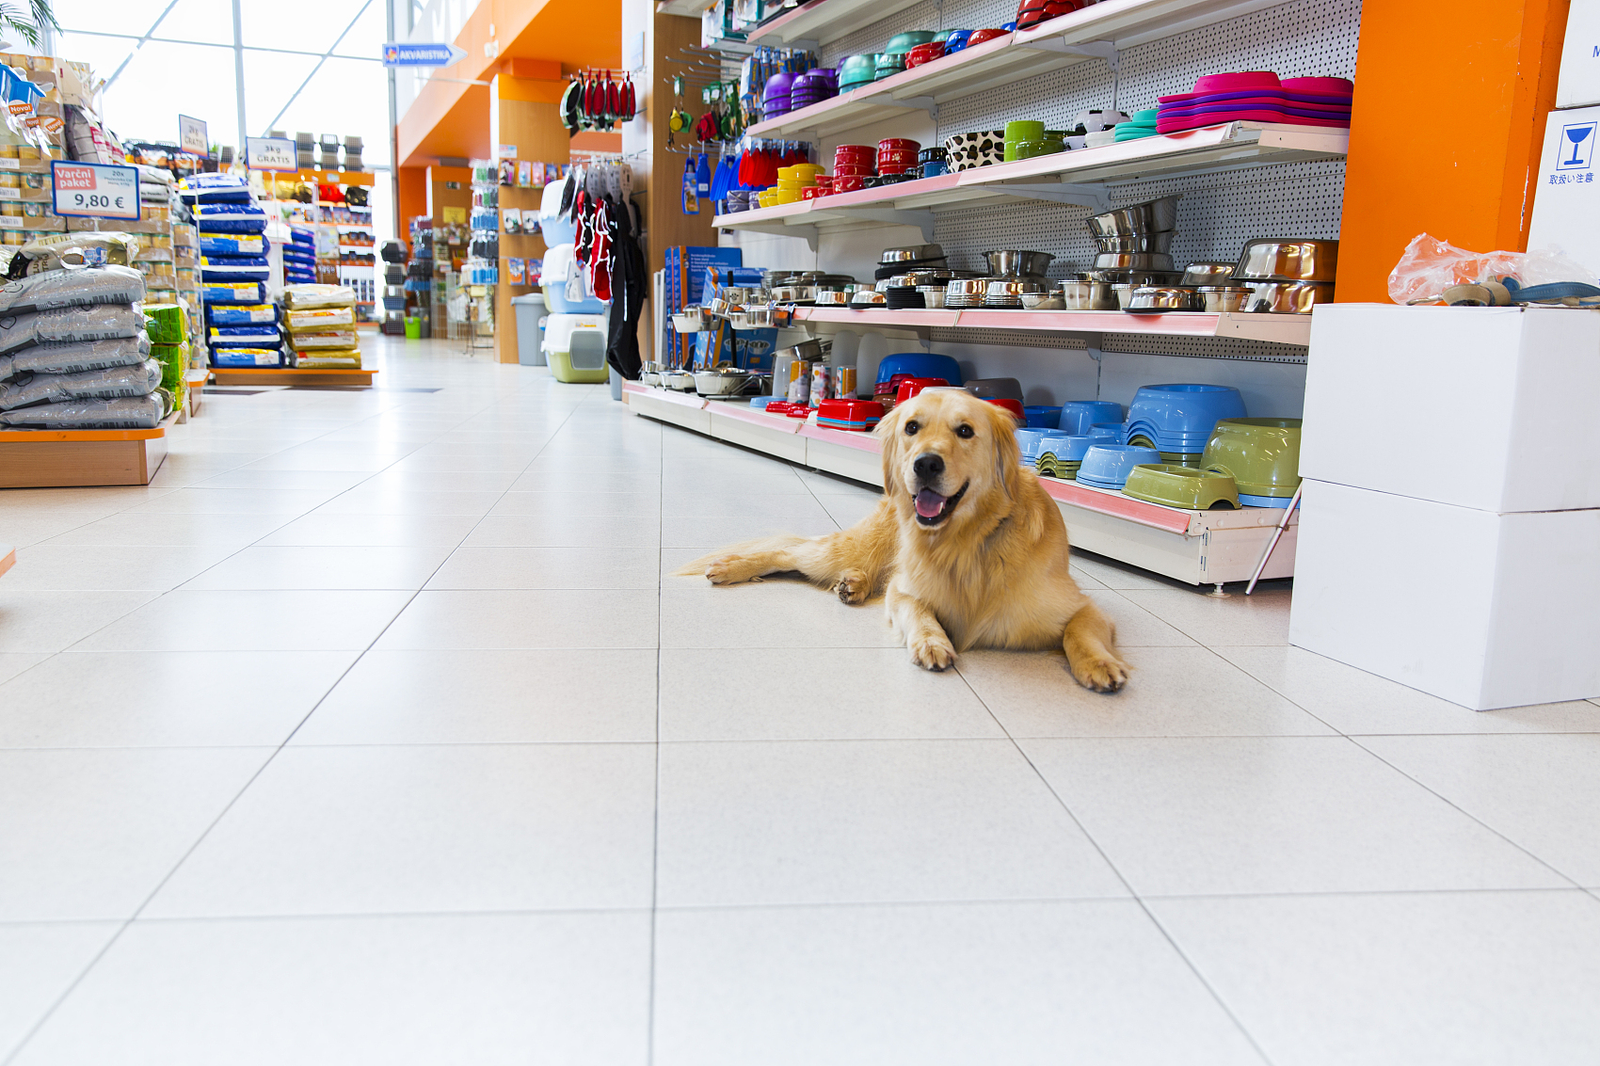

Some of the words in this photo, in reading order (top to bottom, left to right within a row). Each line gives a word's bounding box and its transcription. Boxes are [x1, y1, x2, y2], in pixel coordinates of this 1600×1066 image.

[400, 49, 451, 60] AKVARISTIKA
[257, 155, 290, 164] GRATIS
[56, 169, 91, 179] Varčni
[1548, 172, 1594, 185] 取扱い注意
[60, 179, 91, 189] paket
[74, 193, 109, 209] 9,80
[114, 196, 124, 209] €
